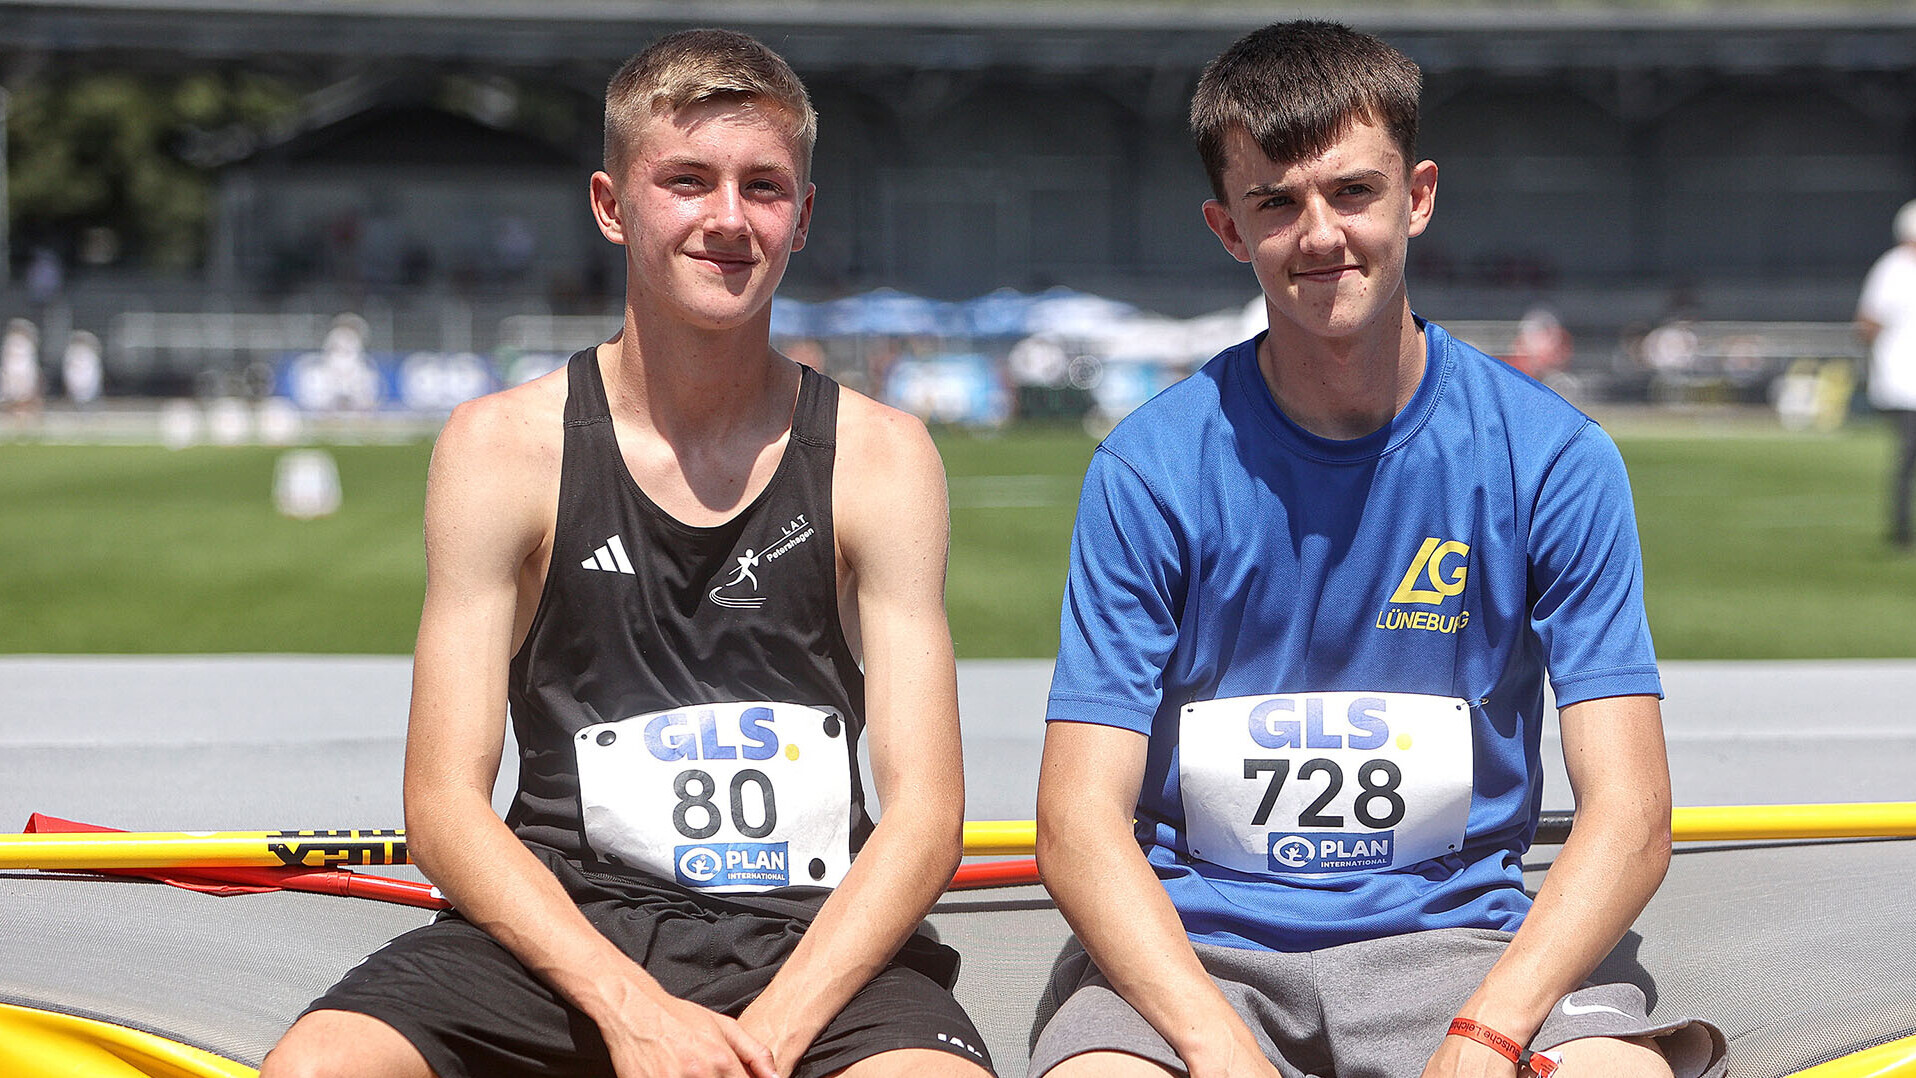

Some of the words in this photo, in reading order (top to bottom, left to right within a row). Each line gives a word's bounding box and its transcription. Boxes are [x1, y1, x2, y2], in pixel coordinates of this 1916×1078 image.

[765, 527, 815, 563] Petershagen
[1389, 537, 1470, 605] LG
[672, 768, 777, 839] 80
[1243, 758, 1406, 829] 728
[725, 850, 785, 871] PLAN
[1320, 840, 1389, 858] PLAN
[1320, 858, 1388, 868] INTERNATIONAL
[727, 872, 786, 881] INTERNATIONAL
